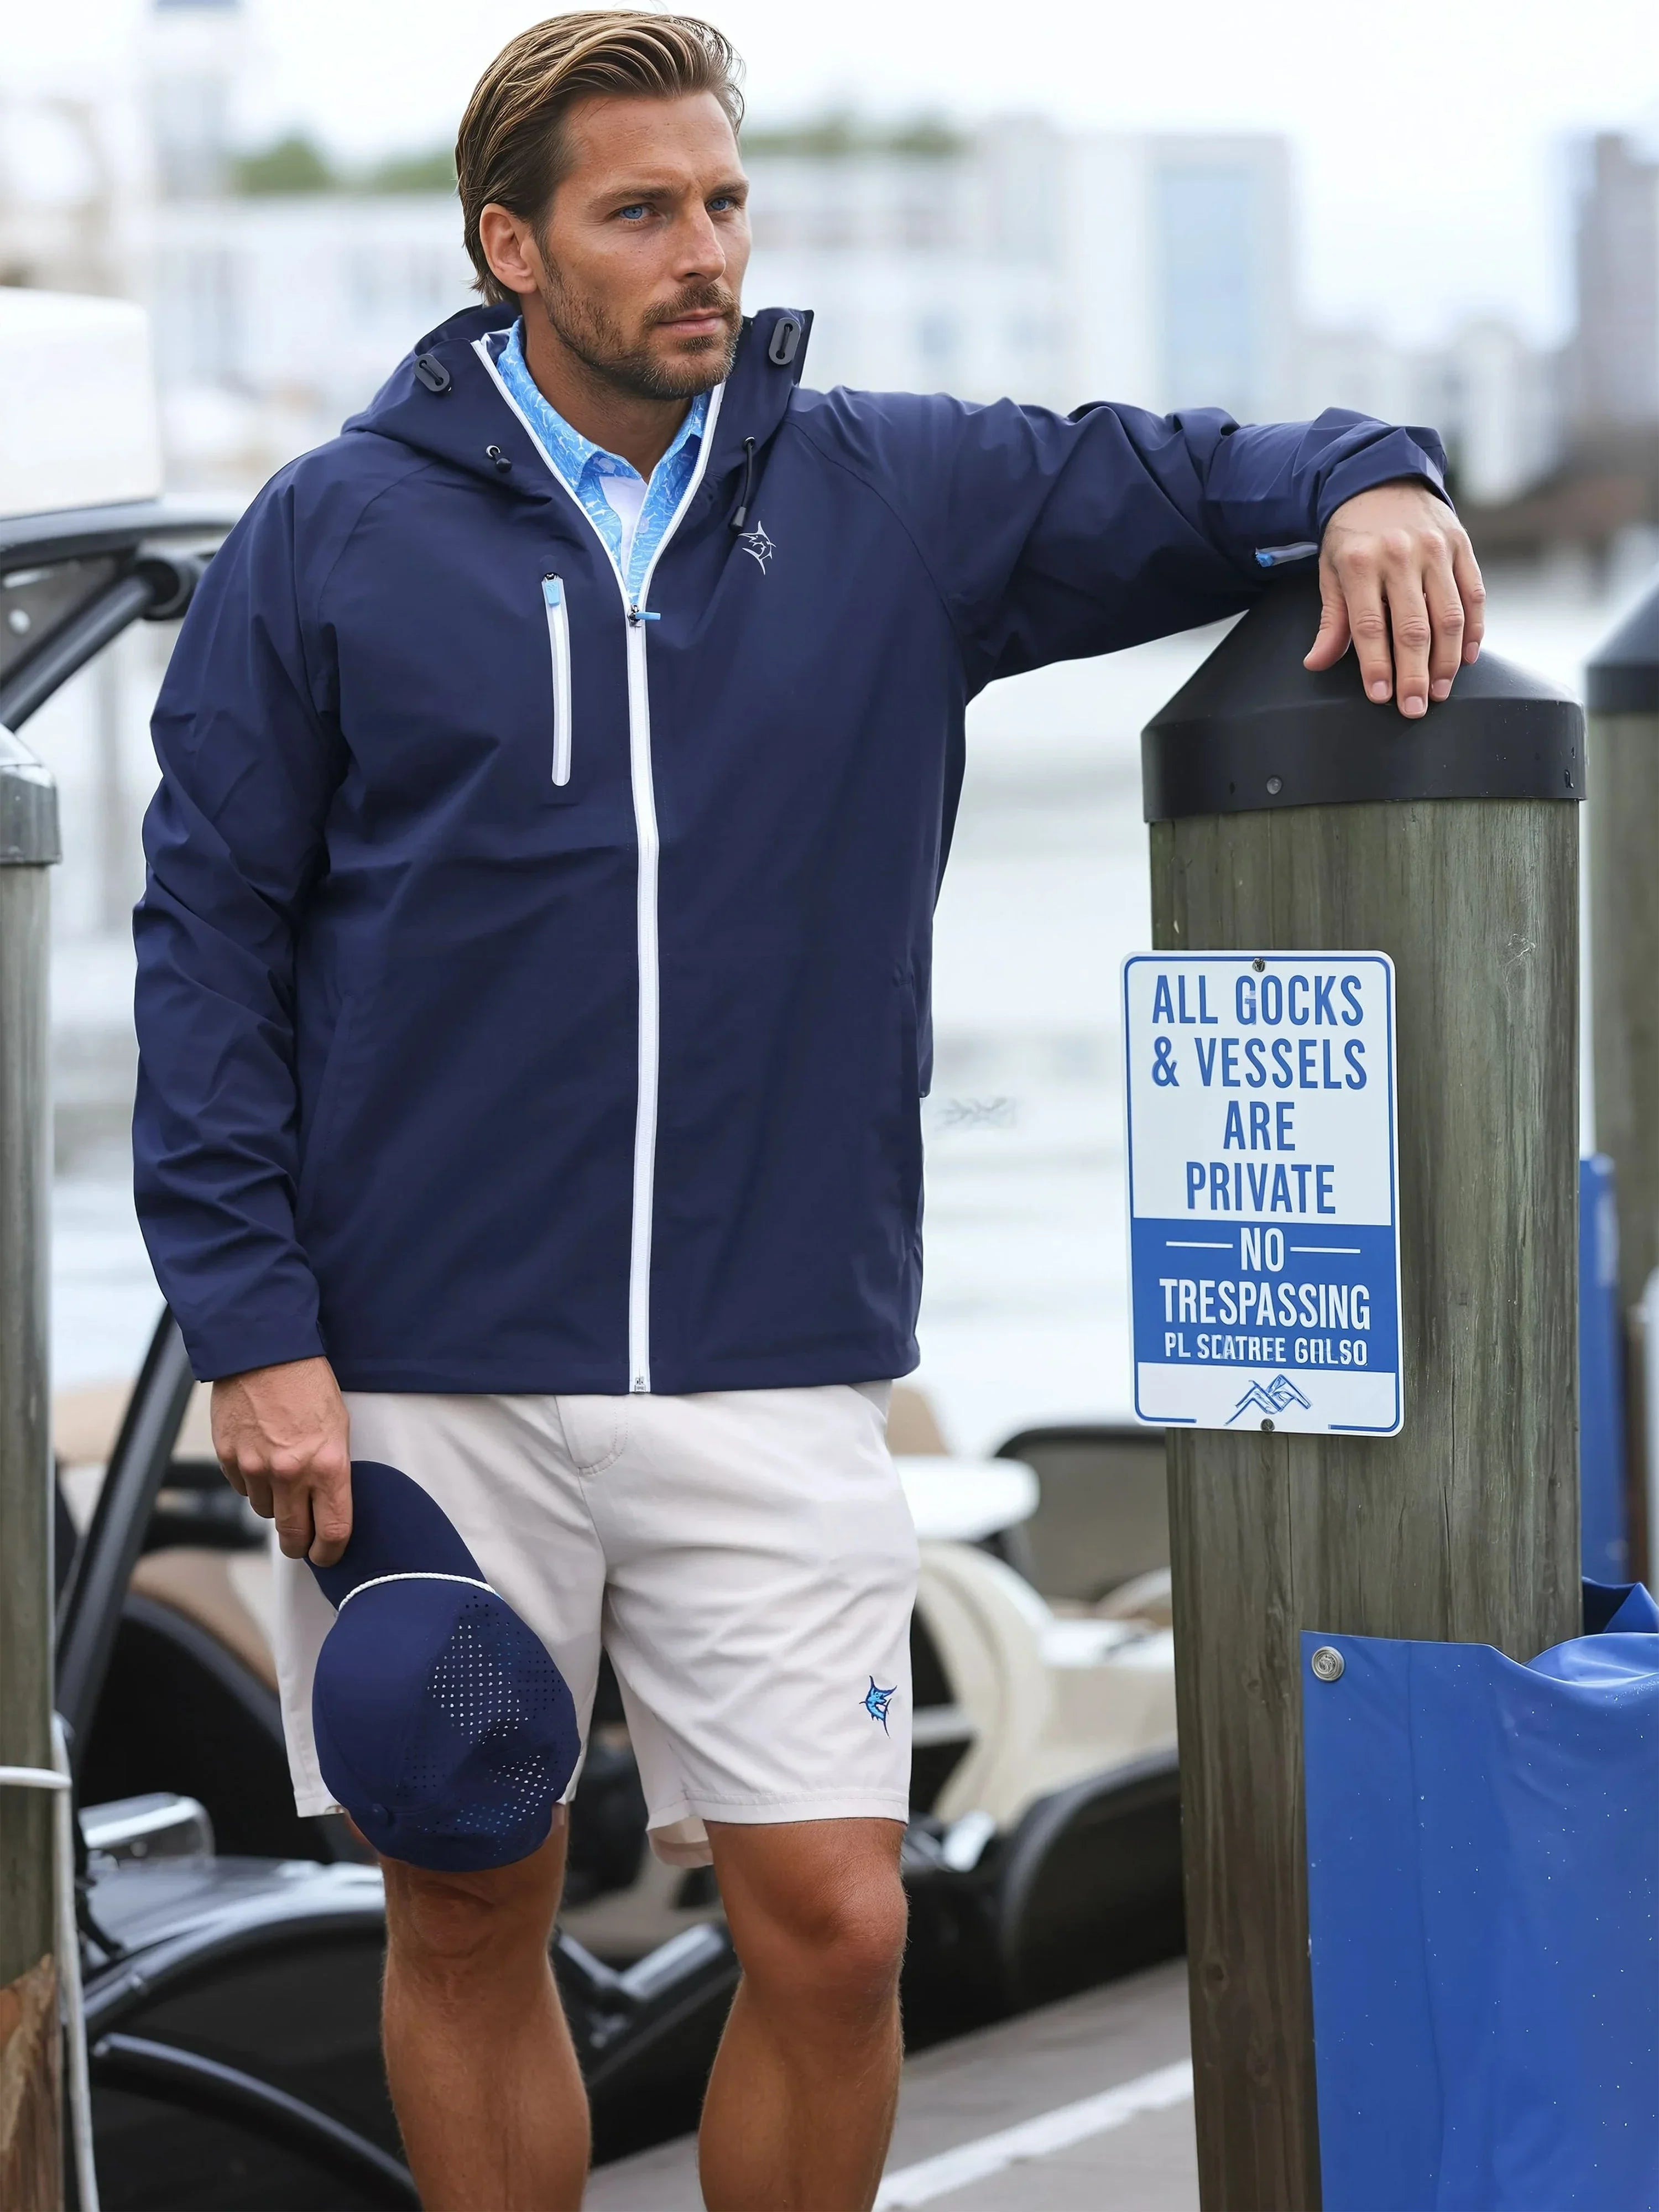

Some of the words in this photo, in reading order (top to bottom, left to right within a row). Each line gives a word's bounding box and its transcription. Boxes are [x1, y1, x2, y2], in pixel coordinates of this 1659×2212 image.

[1152, 975, 1218, 1024] ALL
[1152, 1036, 1180, 1087] &
[1194, 1037, 1367, 1090] VESSELS
[1223, 1100, 1296, 1151] ARE
[1186, 1161, 1336, 1214] PRIVATE
[1240, 1227, 1285, 1272] NO
[1159, 1278, 1371, 1330] TRESPASSING
[1164, 1332, 1191, 1358] PL
